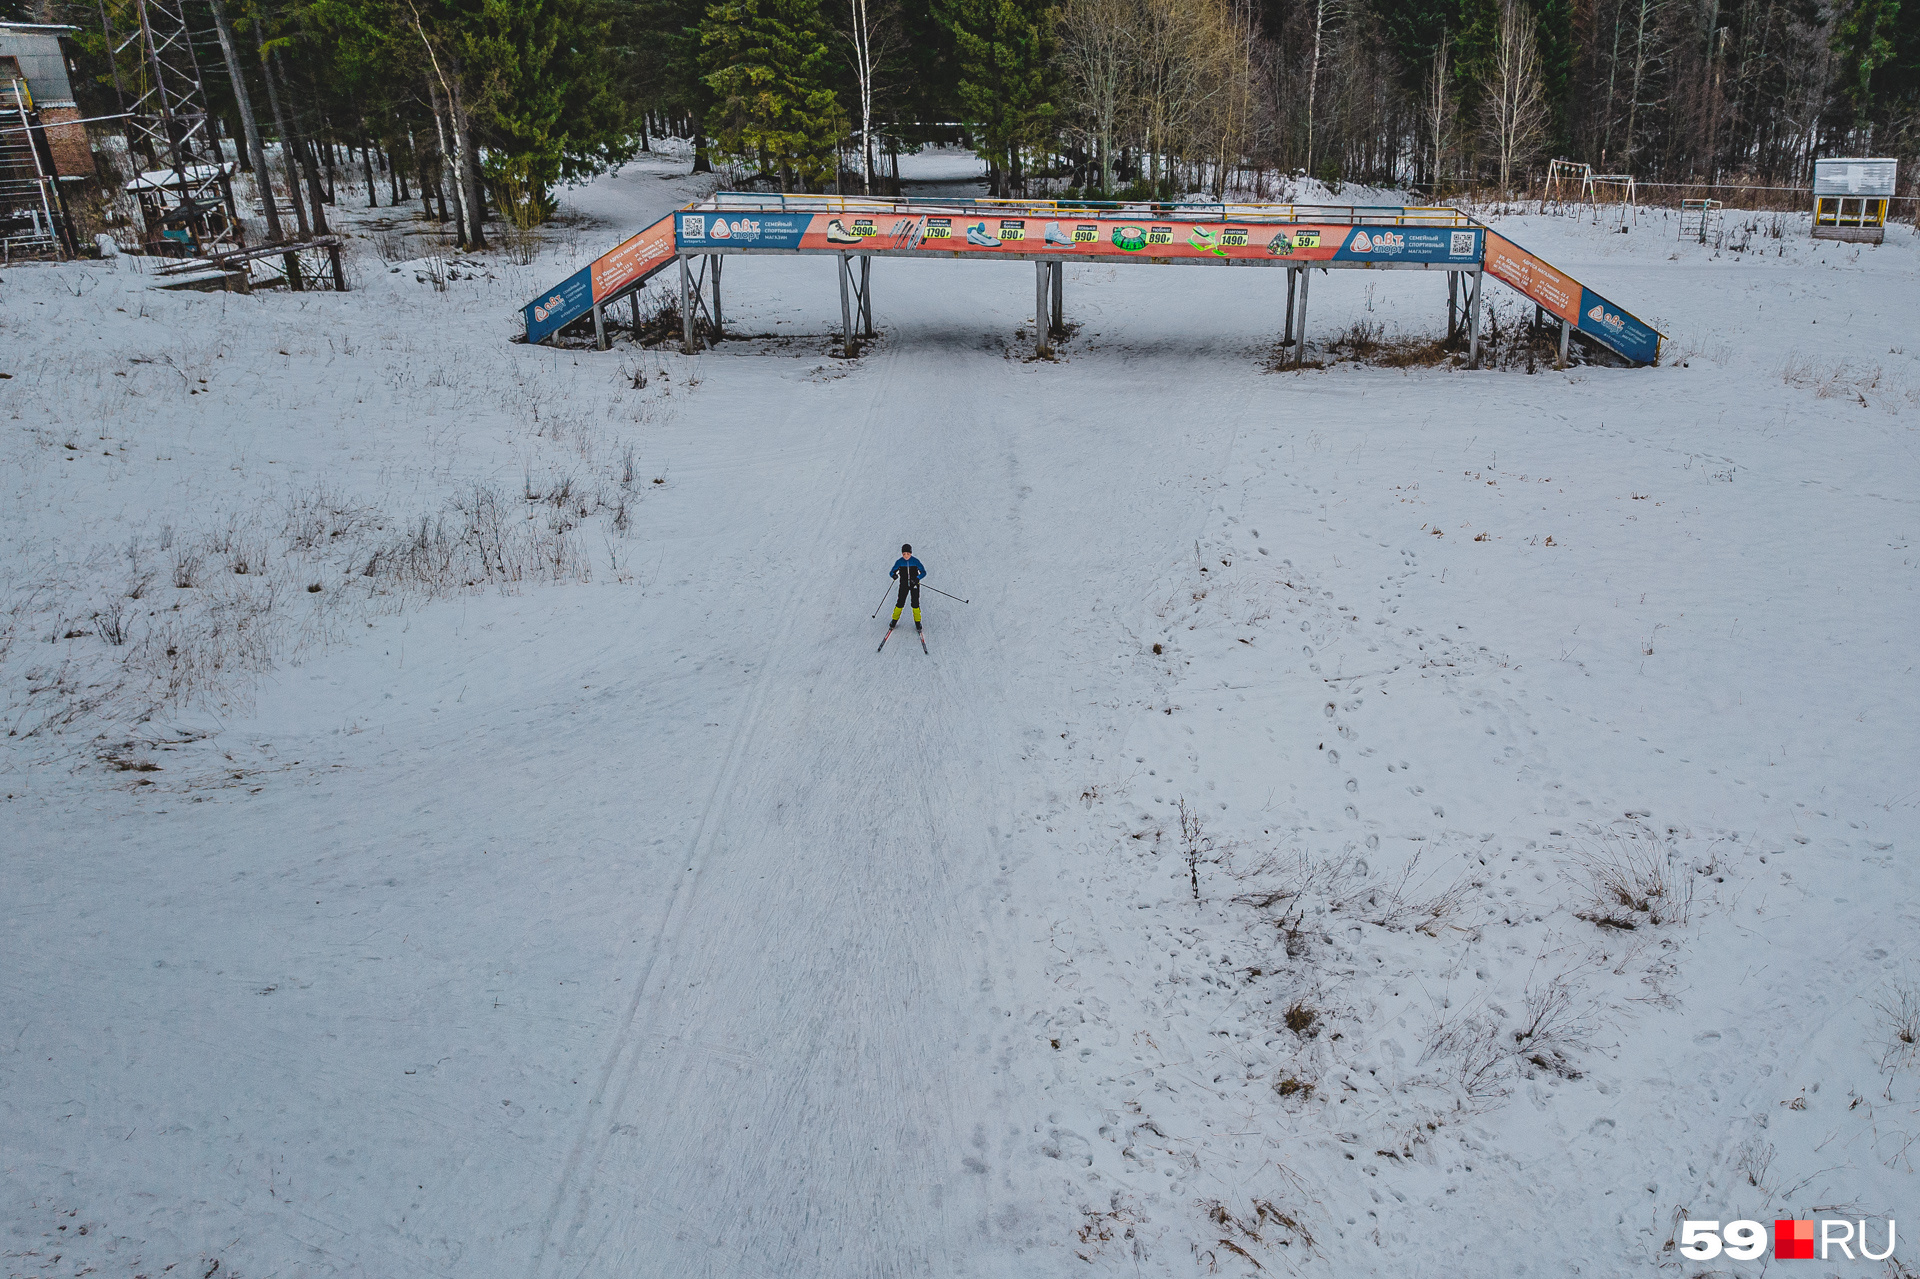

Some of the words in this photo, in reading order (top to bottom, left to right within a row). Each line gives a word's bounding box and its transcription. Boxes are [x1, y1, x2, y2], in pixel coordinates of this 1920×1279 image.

[851, 226, 872, 235] 2990
[927, 228, 945, 237] 1790
[1001, 230, 1018, 239] 890
[732, 232, 760, 242] спорт
[1075, 232, 1092, 241] 990
[1149, 233, 1166, 243] 890
[1222, 235, 1243, 245] 1490
[1298, 237, 1310, 246] 59
[623, 239, 644, 254] МАГАЗИНОВ
[1372, 245, 1404, 256] спорт
[1522, 259, 1538, 270] АДРЕСА
[1537, 267, 1560, 284] МАГАЗИНОВ
